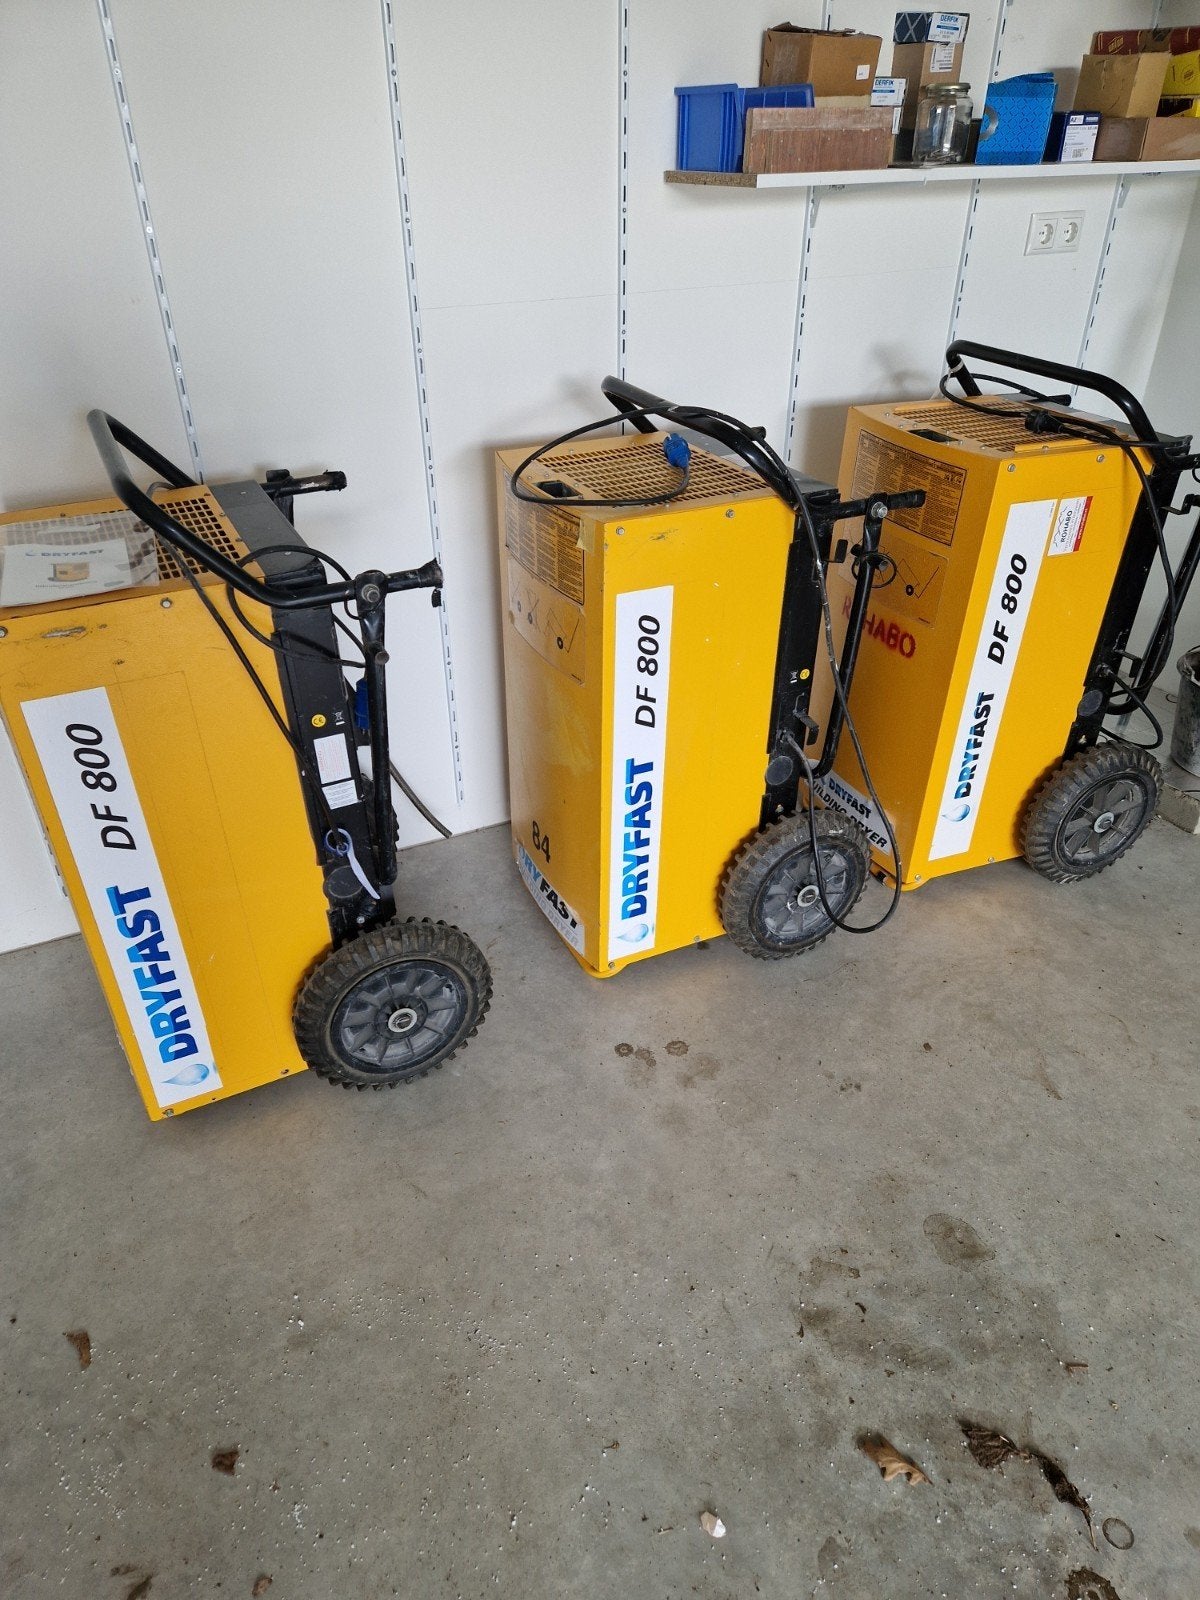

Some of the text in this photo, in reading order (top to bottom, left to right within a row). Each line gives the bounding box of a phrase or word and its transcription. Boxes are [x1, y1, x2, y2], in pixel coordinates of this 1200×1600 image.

[940, 14, 959, 22] DERFIX
[1060, 510, 1073, 542] ROHABO
[841, 595, 917, 658] RHABO
[954, 552, 1028, 800] DRYFAST DF 800
[621, 613, 661, 921] DRYFAST DF 800
[813, 779, 848, 814] UILDIN
[828, 777, 872, 819] DRYFAST
[65, 722, 199, 1064] DRYFAST DF 800
